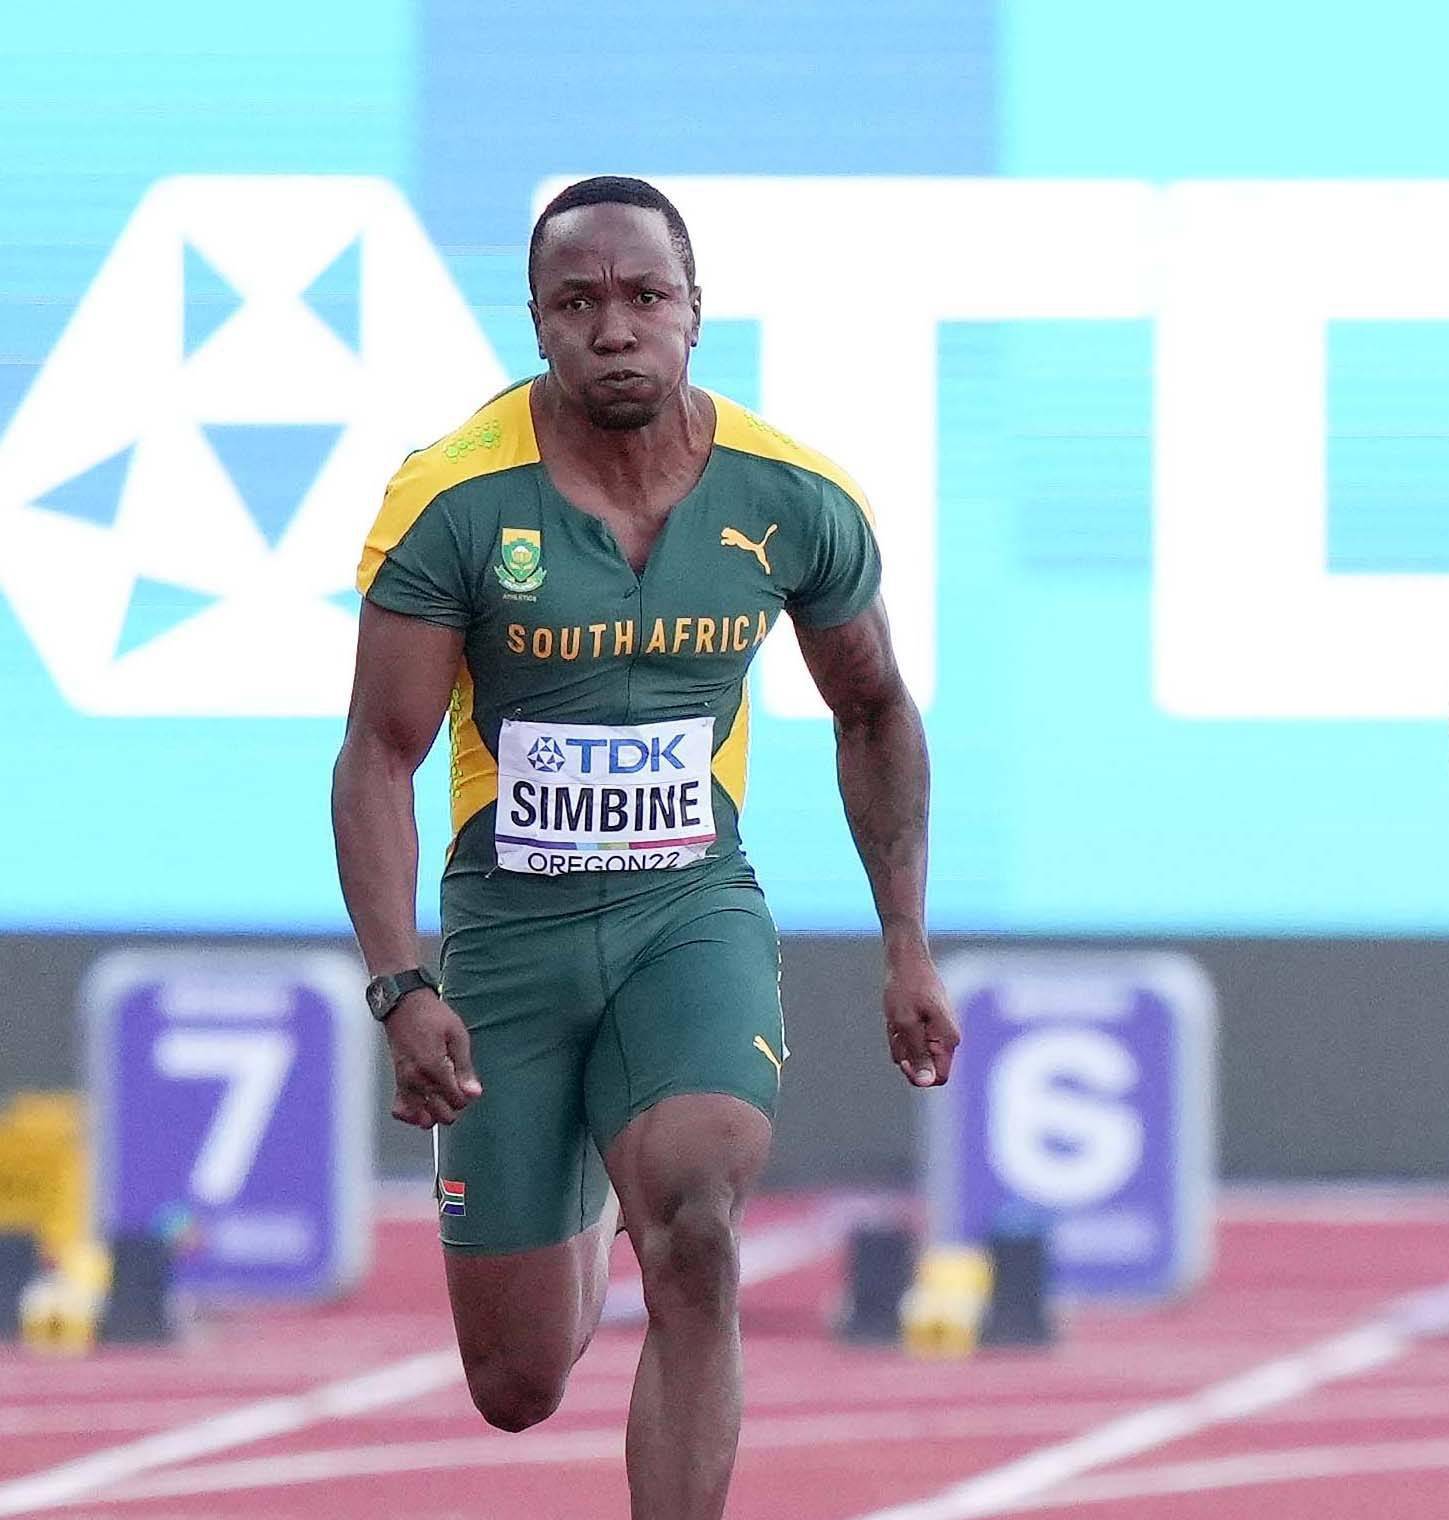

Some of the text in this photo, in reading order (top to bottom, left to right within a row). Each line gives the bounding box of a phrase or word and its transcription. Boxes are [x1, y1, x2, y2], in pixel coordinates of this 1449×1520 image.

[507, 619, 633, 660] SOUTH
[565, 733, 686, 774] TDK
[510, 780, 701, 833] SIMBINE
[527, 852, 680, 874] OREGON22
[154, 1030, 294, 1203] 7
[987, 1027, 1145, 1206] 6
